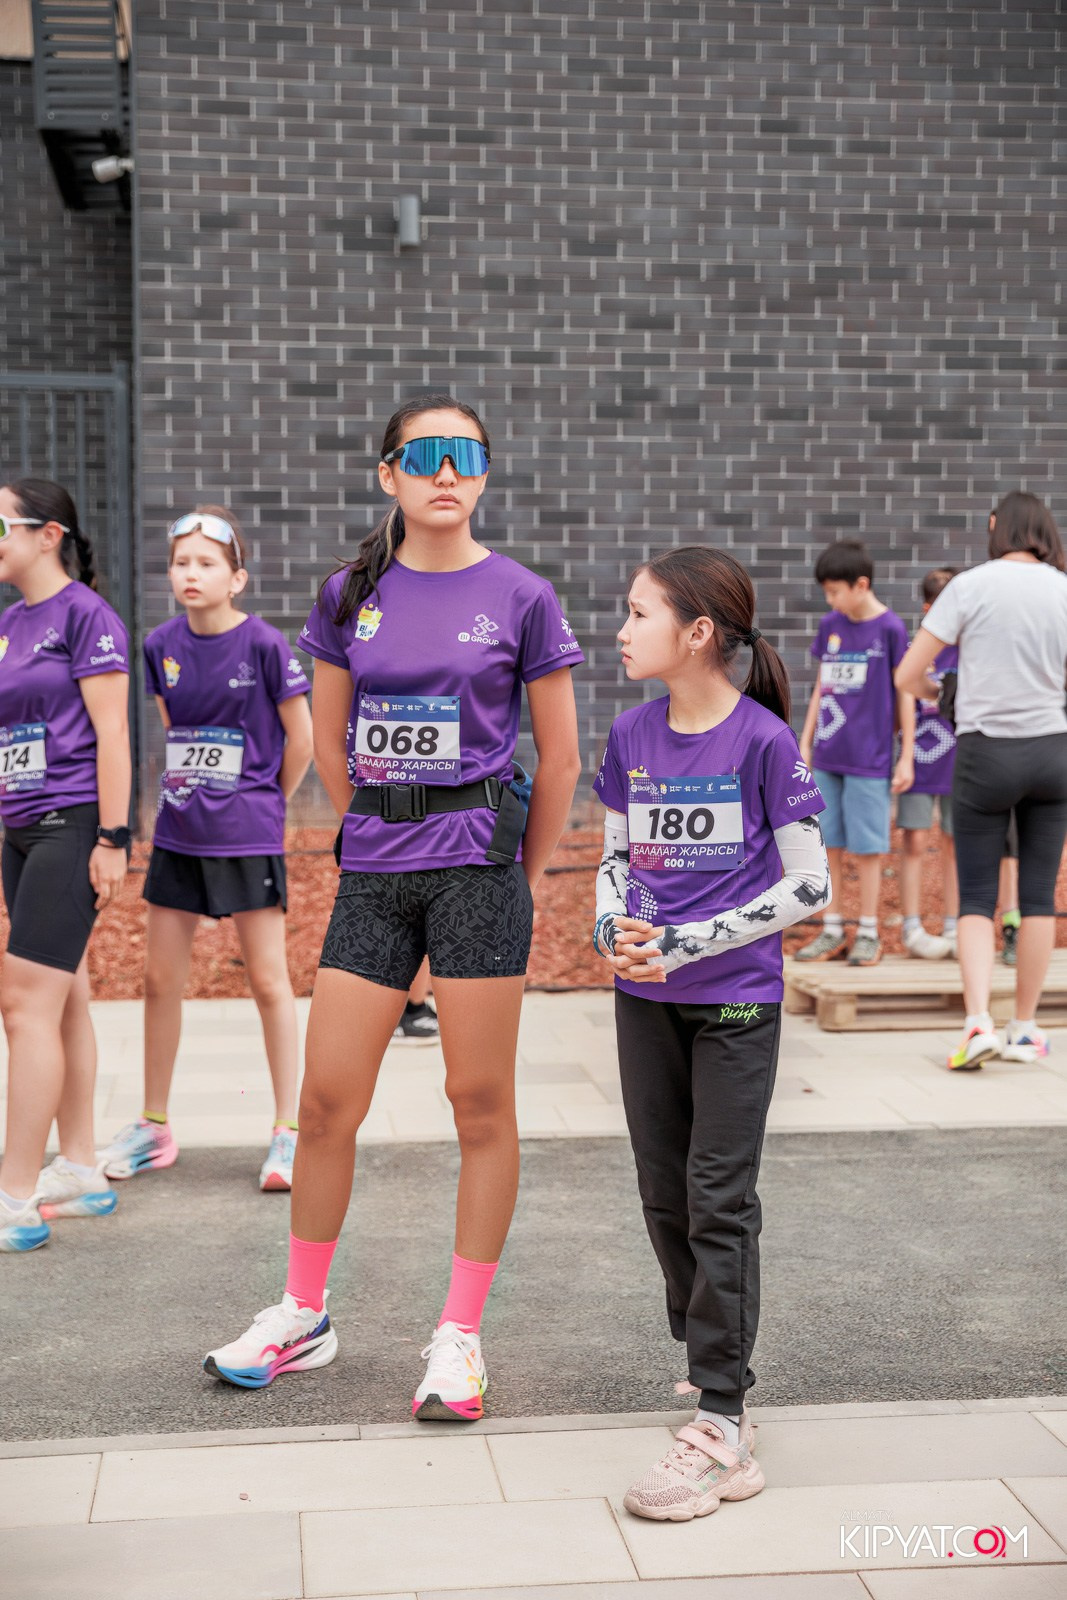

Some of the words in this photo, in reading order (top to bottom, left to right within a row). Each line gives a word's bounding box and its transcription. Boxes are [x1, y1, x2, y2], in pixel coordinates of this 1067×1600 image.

[470, 635, 499, 646] GROUP
[366, 723, 440, 756] 068
[182, 746, 223, 767] 218
[357, 755, 399, 770] БАЛАЛАР
[401, 760, 456, 771] ЖАРЫСЫ
[385, 770, 407, 780] 600
[648, 807, 715, 841] 180
[632, 844, 677, 857] БАЛАЛАР
[678, 844, 738, 857] ЖАРЫСЫ
[663, 858, 685, 868] 600
